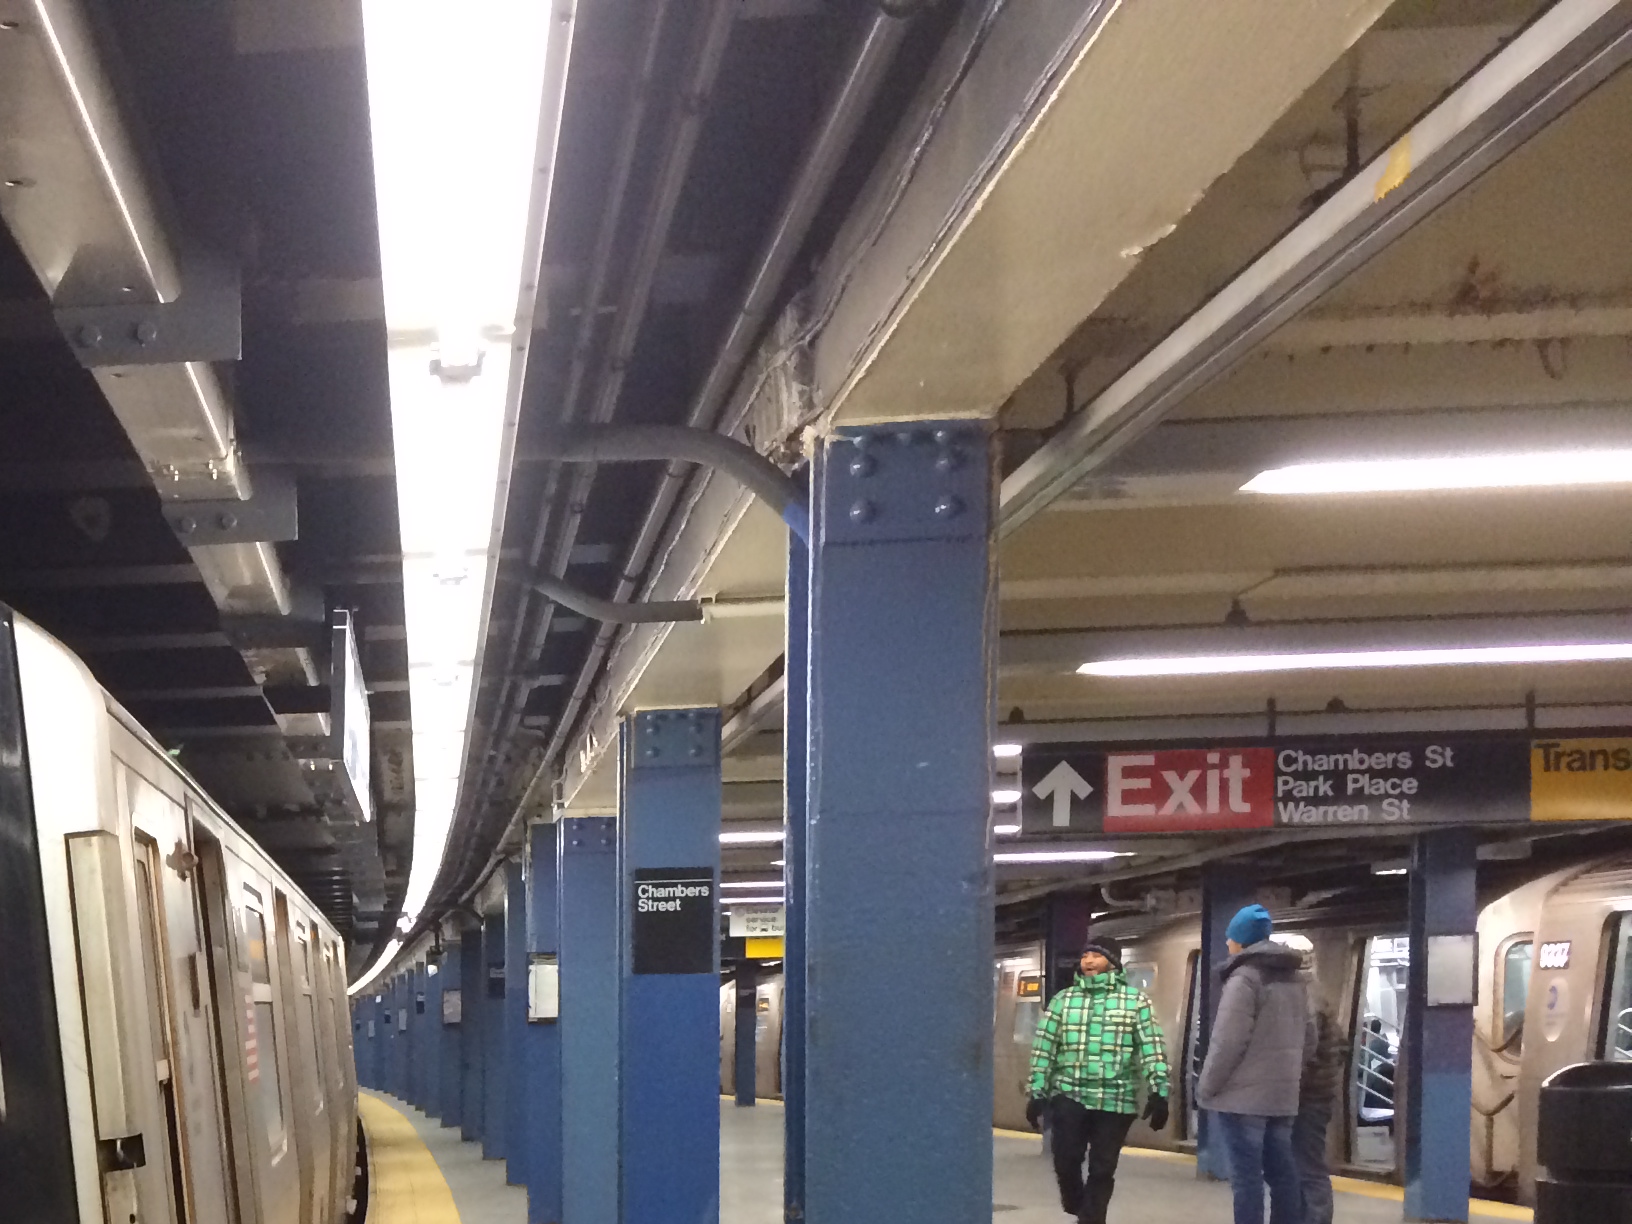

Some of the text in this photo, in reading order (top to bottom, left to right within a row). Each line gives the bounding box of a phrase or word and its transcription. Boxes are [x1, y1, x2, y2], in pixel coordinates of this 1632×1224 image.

[1277, 745, 1455, 773] Chambers St
[1534, 742, 1631, 773] Trans
[1107, 752, 1251, 817] Exit
[1277, 773, 1419, 798] Park Place
[1278, 797, 1412, 823] Warren St
[637, 884, 710, 898] Chambers
[637, 898, 681, 912] Street
